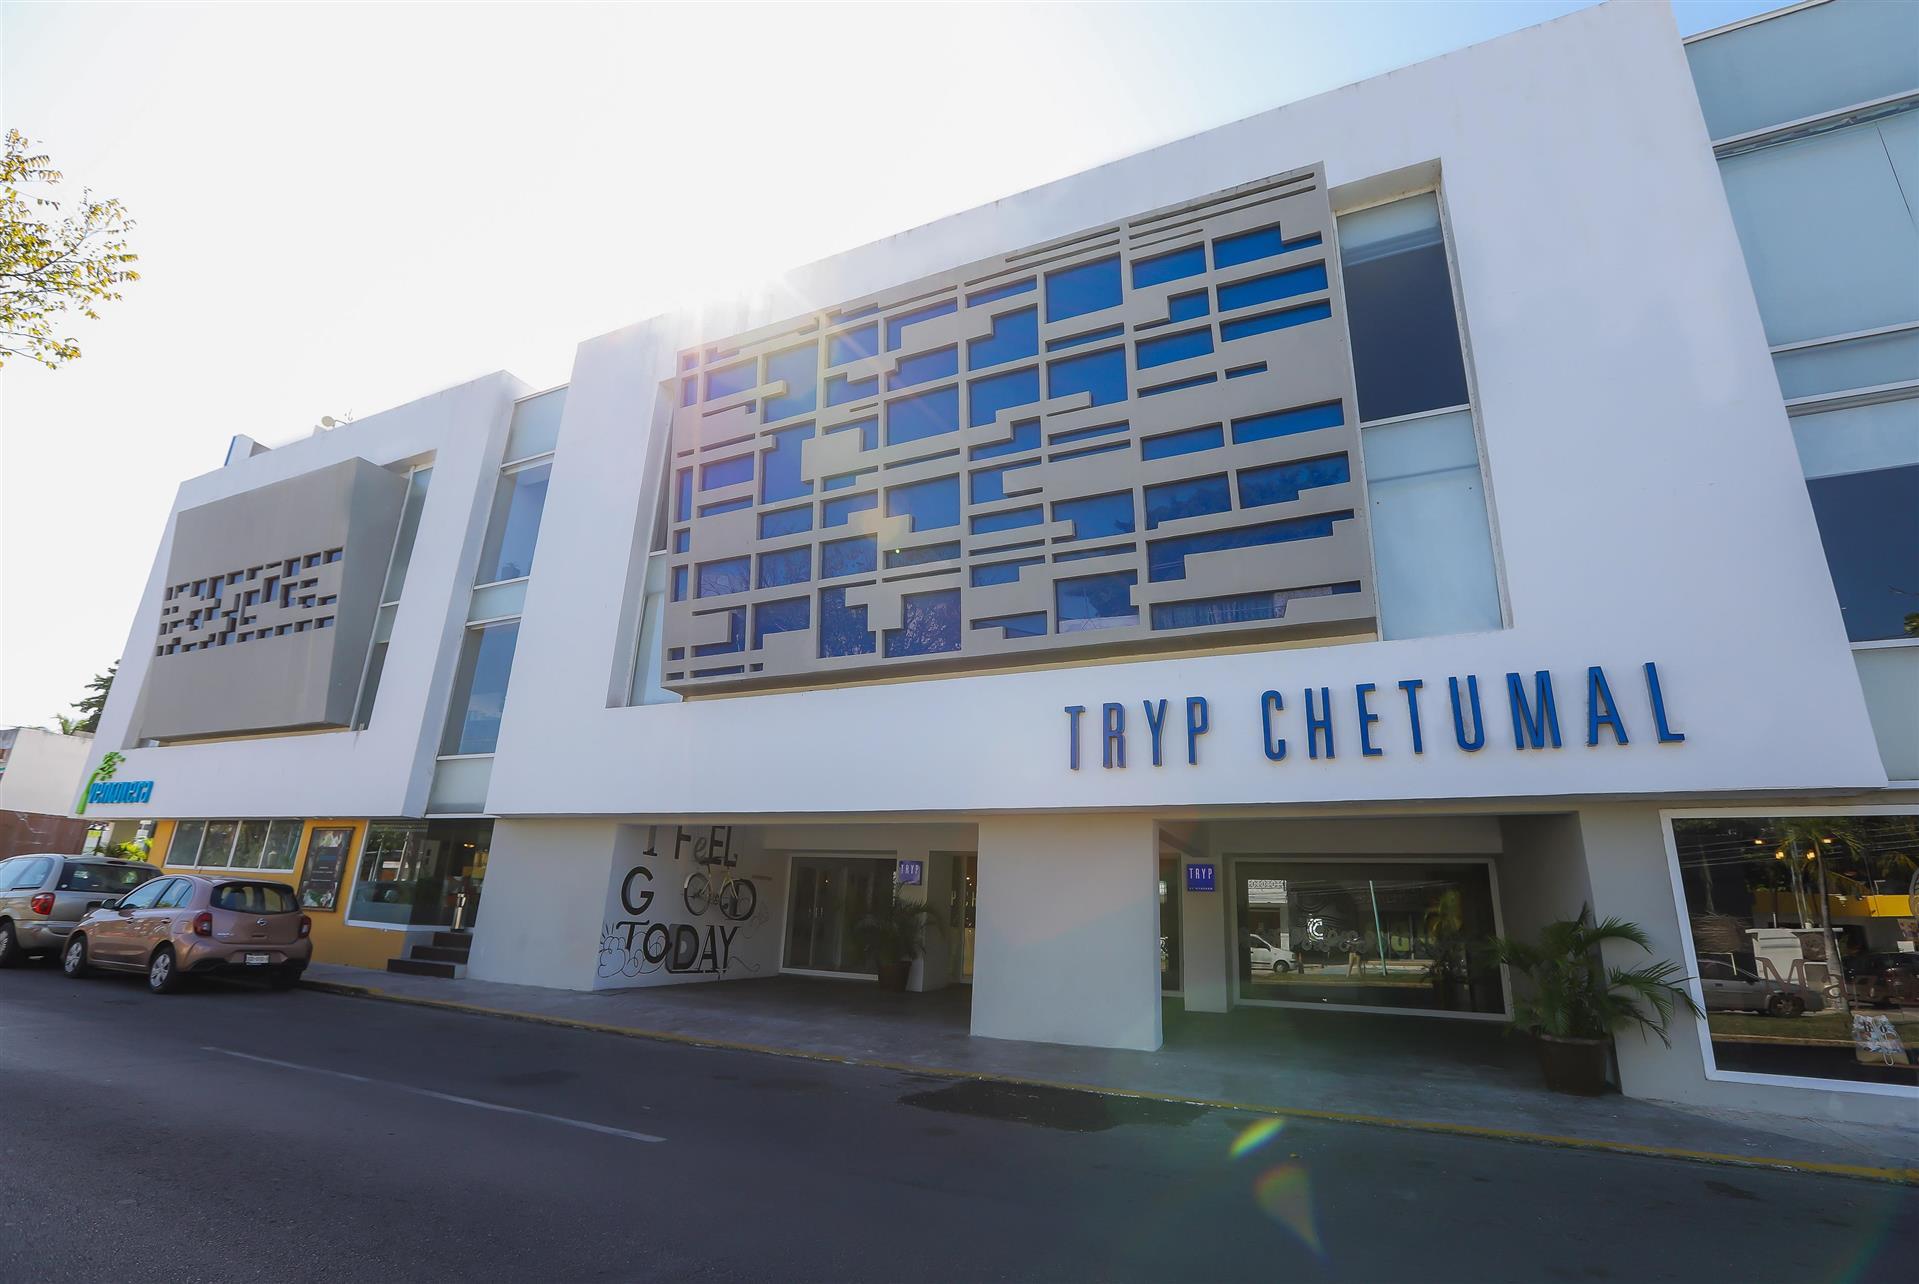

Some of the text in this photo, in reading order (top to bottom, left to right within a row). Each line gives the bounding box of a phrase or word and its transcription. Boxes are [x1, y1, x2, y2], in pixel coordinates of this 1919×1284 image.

[1064, 661, 1687, 771] TRYP CHETUMAL
[901, 864, 920, 874] TRYP
[1188, 867, 1213, 880] TRYP
[615, 919, 742, 974] TODAY
